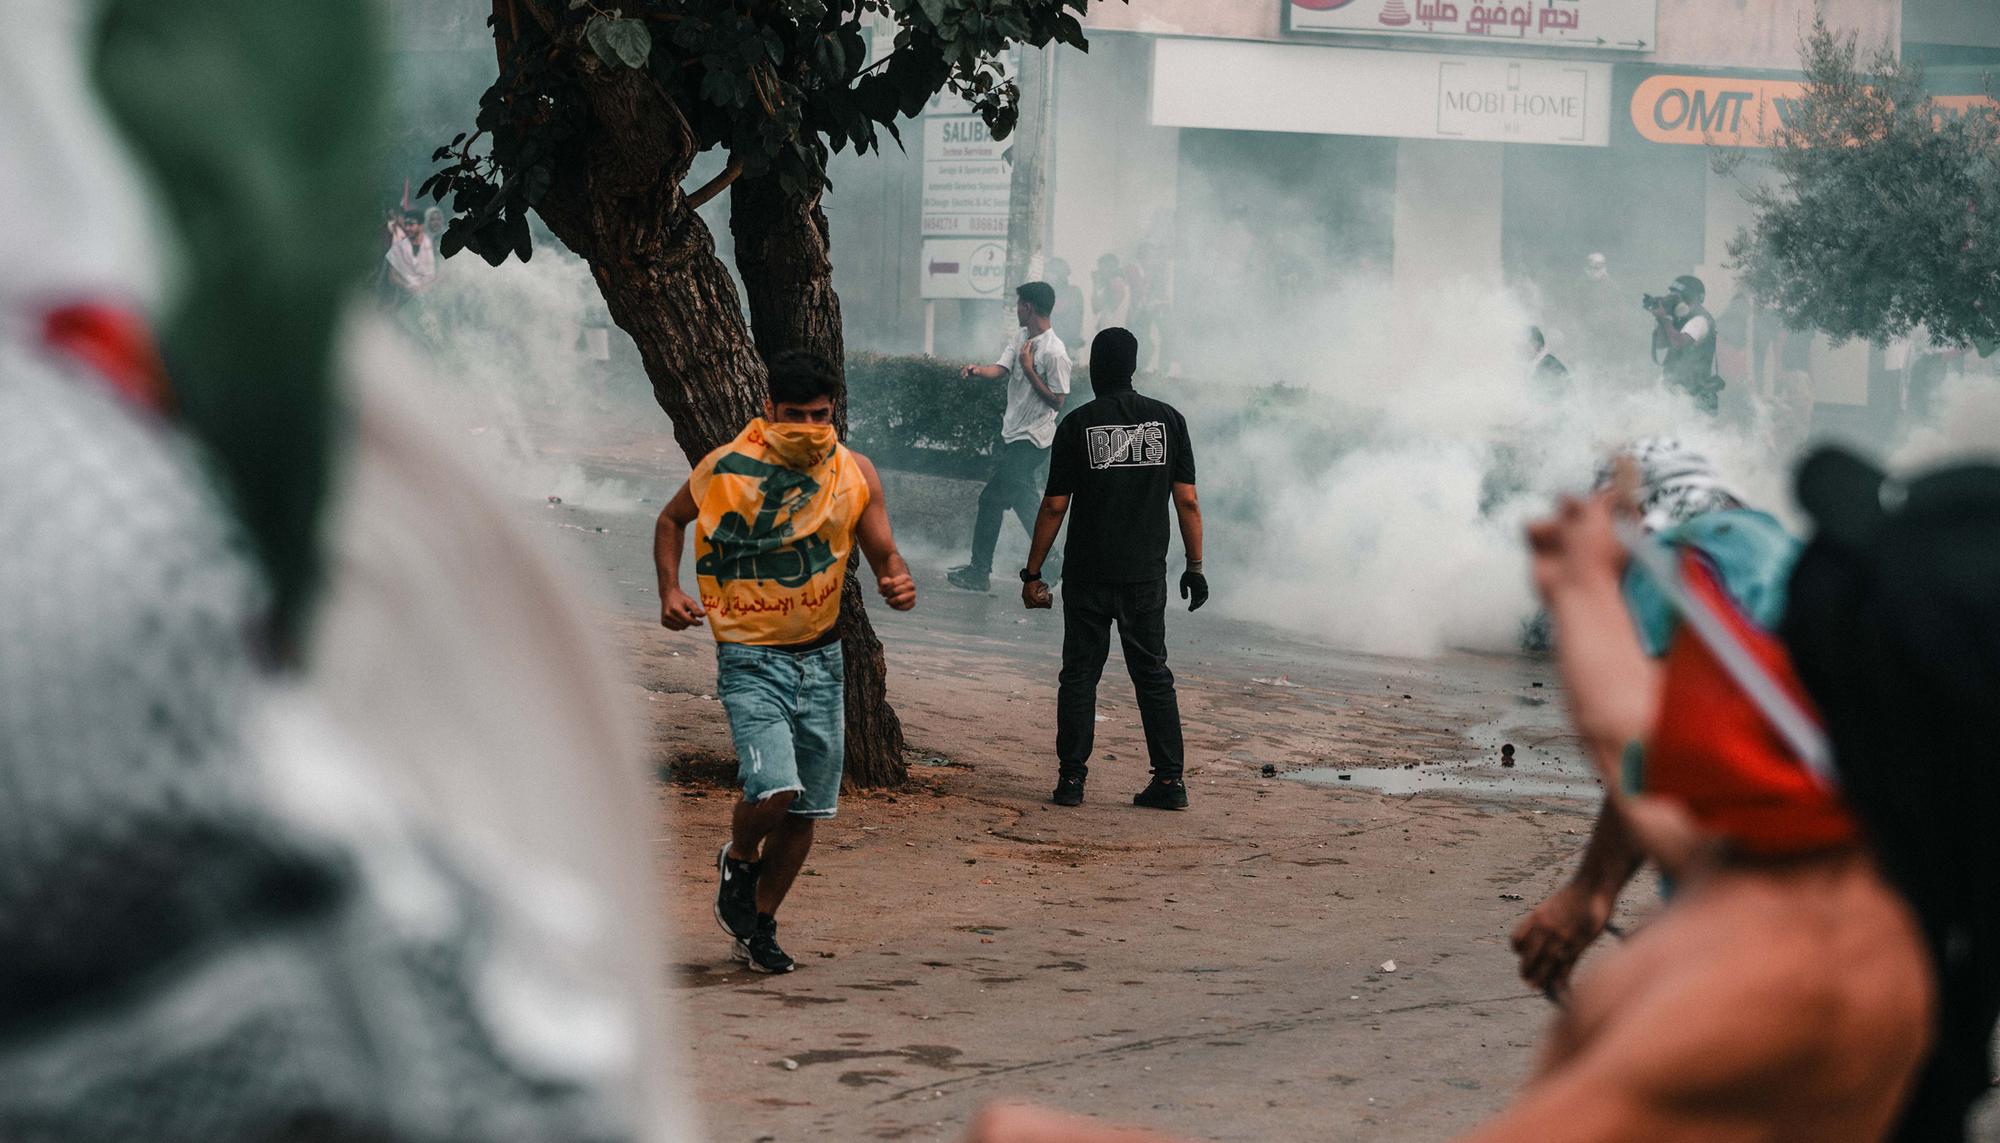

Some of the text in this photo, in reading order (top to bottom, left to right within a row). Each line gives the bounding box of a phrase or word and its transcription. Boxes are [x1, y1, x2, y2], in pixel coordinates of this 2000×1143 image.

[1445, 91, 1579, 118] MOBI HOME
[1653, 88, 1754, 133] OMT
[1090, 427, 1164, 464] BOYS
